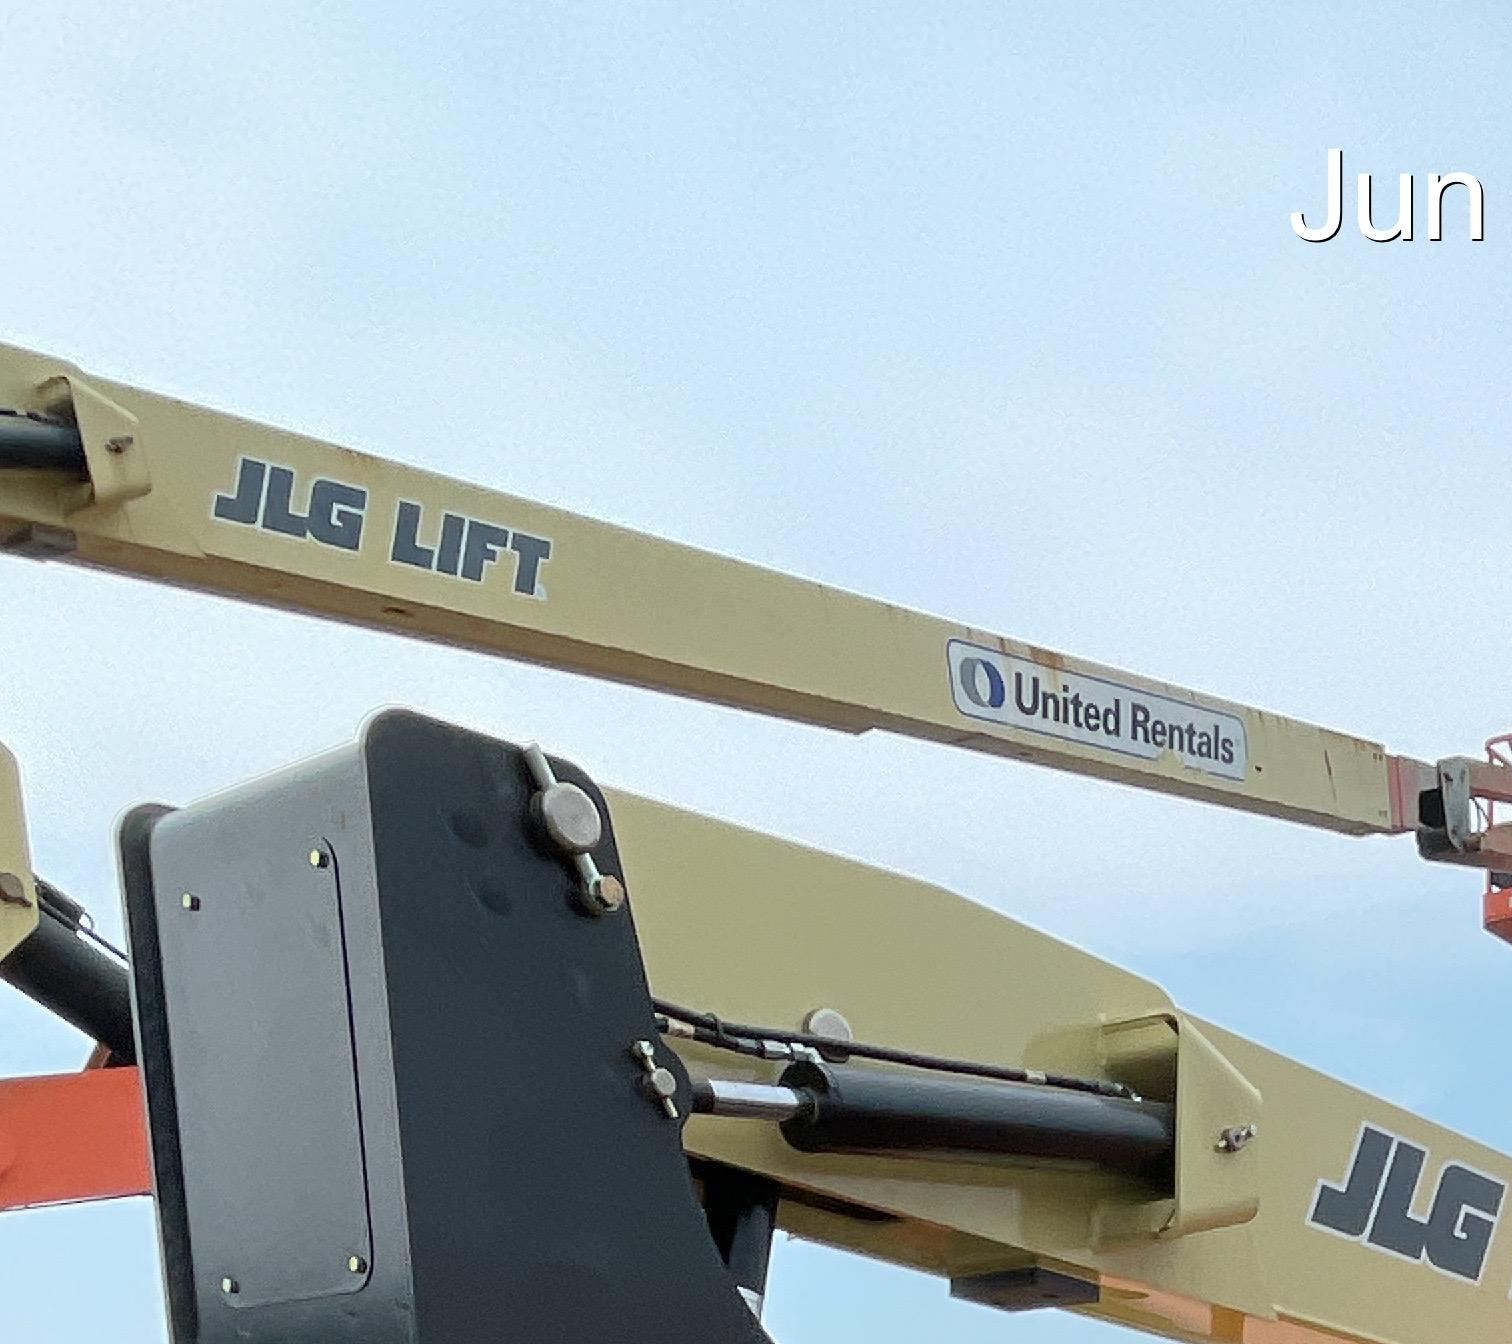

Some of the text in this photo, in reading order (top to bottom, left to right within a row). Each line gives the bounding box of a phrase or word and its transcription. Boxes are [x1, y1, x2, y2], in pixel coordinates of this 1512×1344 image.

[212, 456, 552, 597] JLG LIFT
[1014, 671, 1234, 764] United Rentals
[1305, 1121, 1508, 1287] JLG
